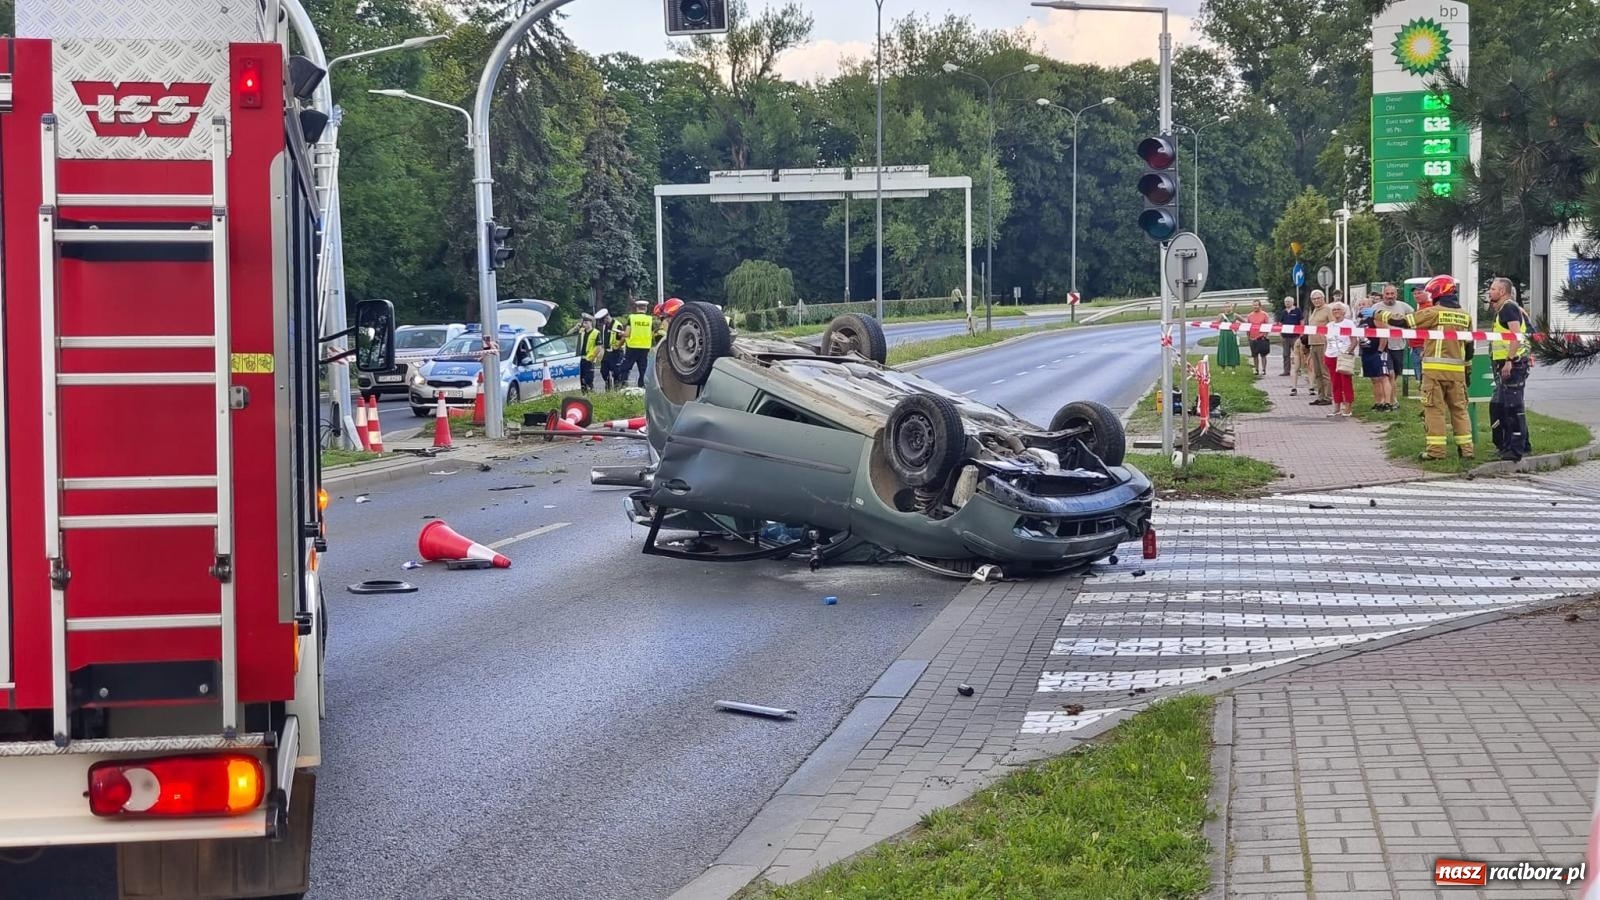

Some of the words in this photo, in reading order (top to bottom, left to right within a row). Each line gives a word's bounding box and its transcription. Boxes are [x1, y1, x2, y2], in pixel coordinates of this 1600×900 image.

[1440, 4, 1458, 20] bp
[97, 94, 191, 124] ISS
[1424, 117, 1451, 132] 632
[1424, 160, 1451, 176] 663
